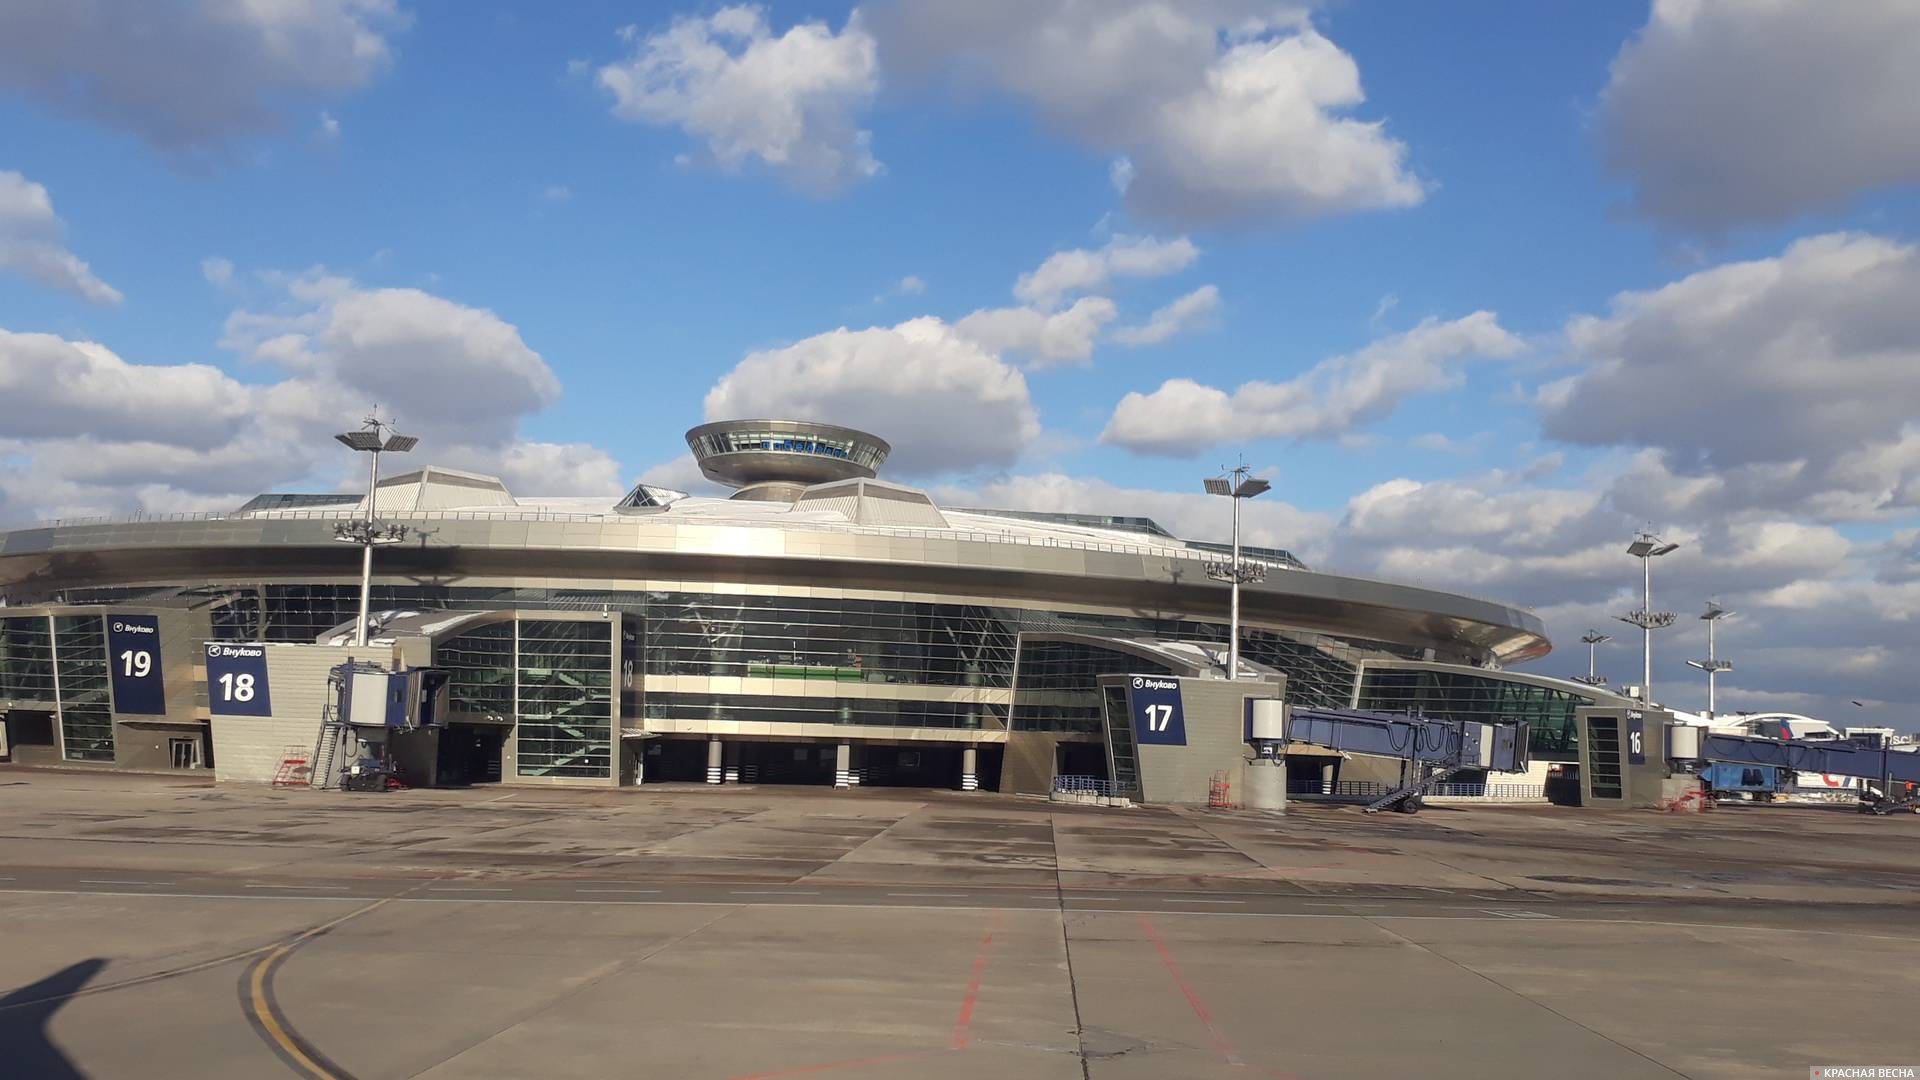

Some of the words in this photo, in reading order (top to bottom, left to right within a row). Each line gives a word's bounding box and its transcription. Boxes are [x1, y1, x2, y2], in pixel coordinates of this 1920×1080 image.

[125, 624, 154, 634] Внуково
[120, 650, 151, 677] 19
[222, 647, 262, 658] Внуково
[623, 659, 634, 688] 18
[1144, 679, 1178, 690] Внуково
[219, 673, 255, 702] 18
[1144, 704, 1173, 731] 17
[1630, 731, 1641, 754] 16
